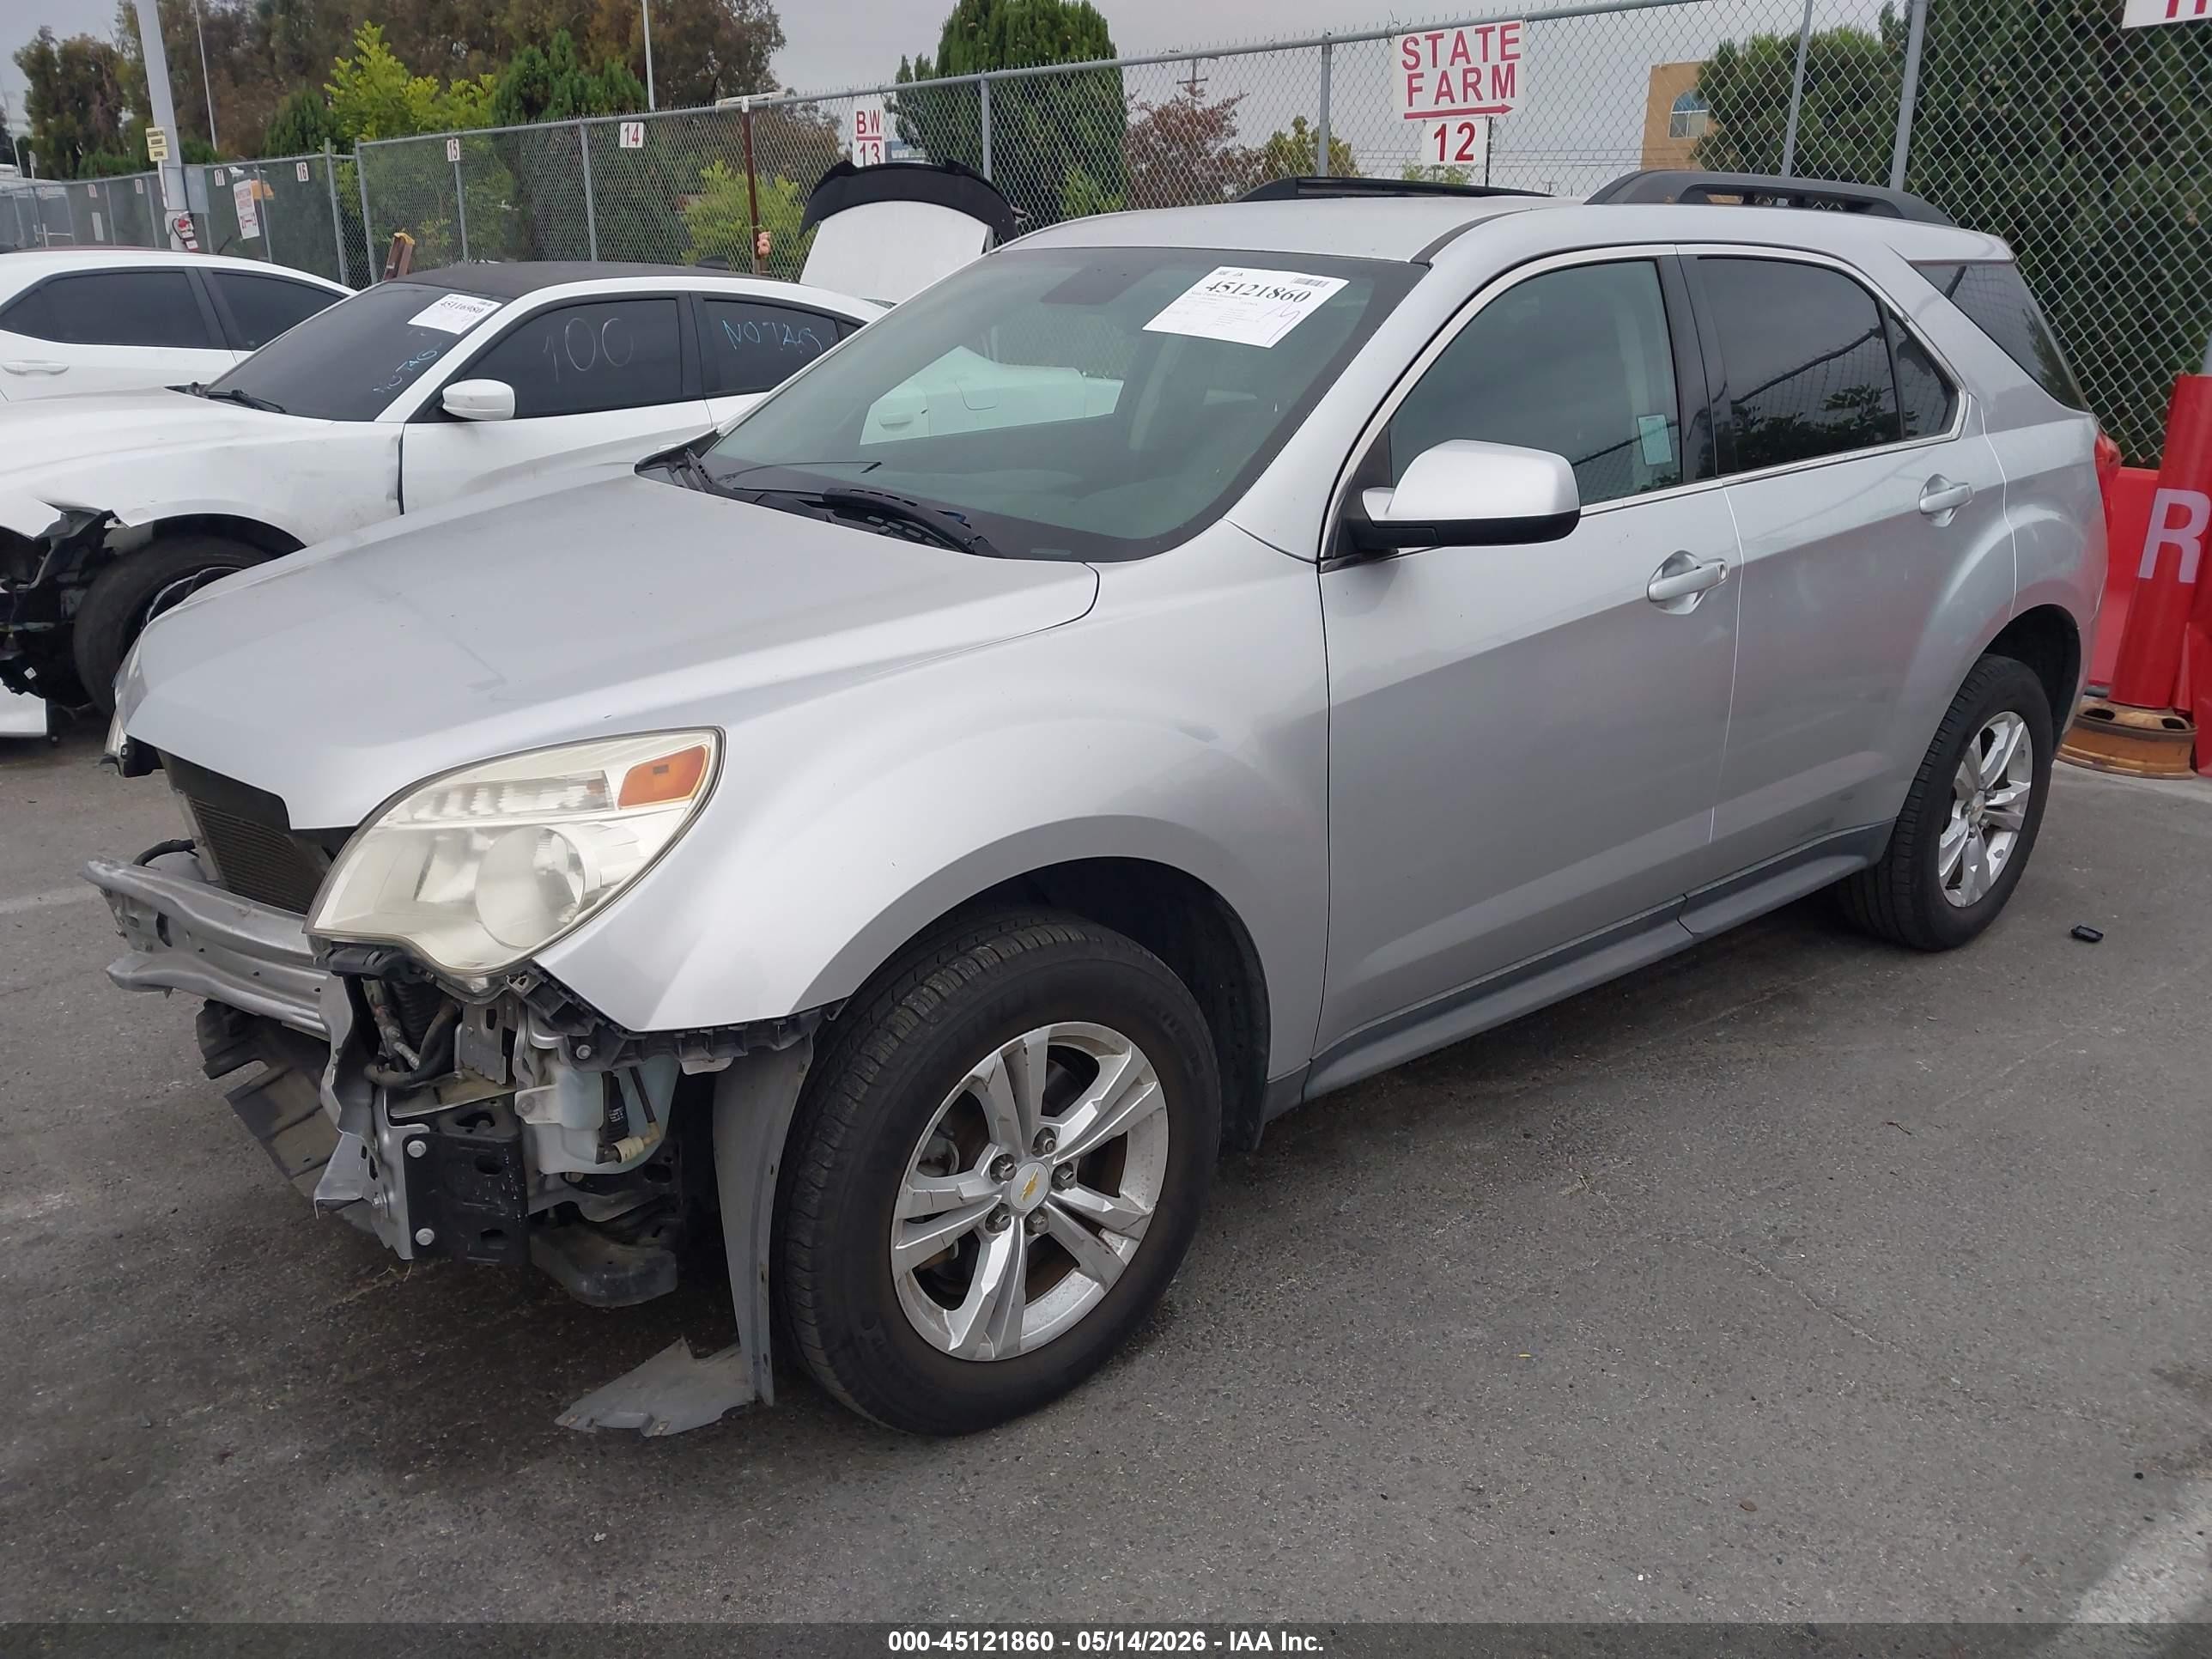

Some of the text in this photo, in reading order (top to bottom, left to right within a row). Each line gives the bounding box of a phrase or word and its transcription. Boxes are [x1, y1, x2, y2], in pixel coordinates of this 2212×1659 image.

[1401, 22, 1521, 70] STATE
[1407, 63, 1516, 107] FARM
[856, 109, 880, 134] BW
[624, 124, 640, 146] 14
[1433, 122, 1476, 161] 12
[448, 140, 459, 160] 15
[860, 143, 880, 166] 13
[299, 164, 307, 179] 16
[1206, 280, 1311, 303] 45121860
[722, 319, 761, 349] NO
[2138, 487, 2211, 583] R
